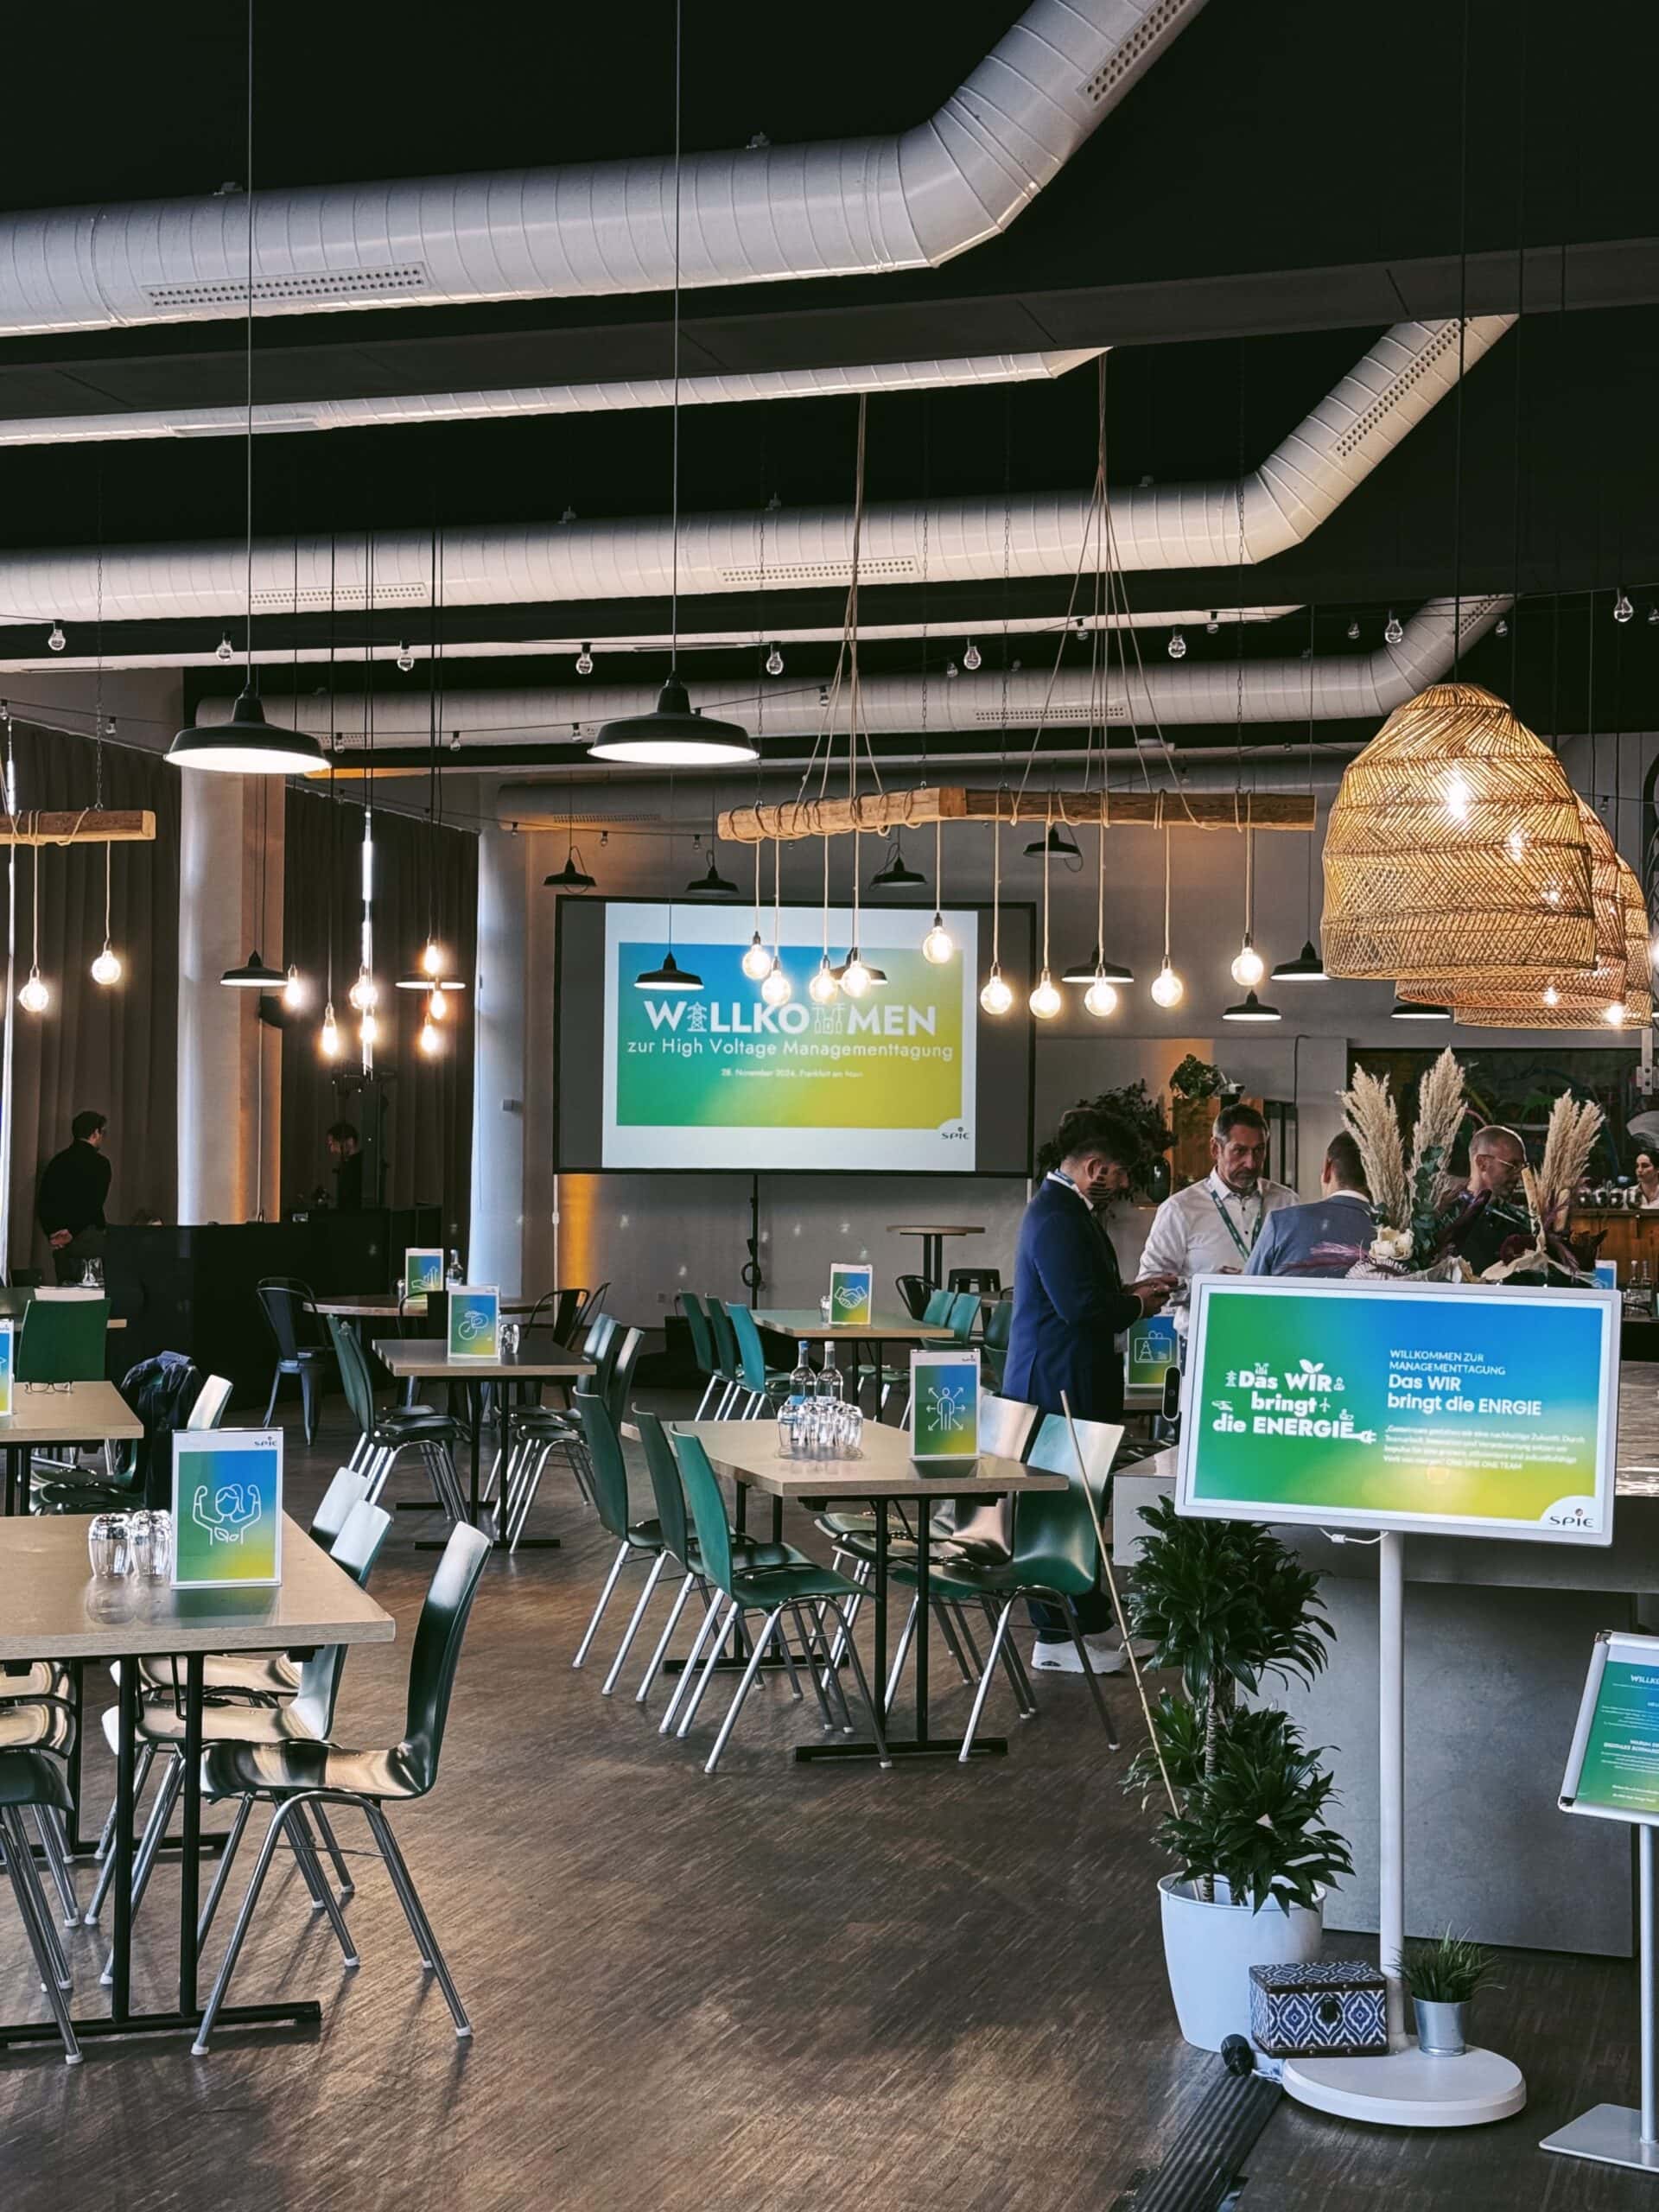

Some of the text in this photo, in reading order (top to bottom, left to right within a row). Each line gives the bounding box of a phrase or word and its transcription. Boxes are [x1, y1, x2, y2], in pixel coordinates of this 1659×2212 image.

[627, 1038, 954, 1062] zur High Voltage Managementtagung
[1389, 1350, 1484, 1363] WILLKOMMEN ZUR
[1389, 1362, 1506, 1376] MANAGEMENTTAGUNG
[1238, 1370, 1332, 1393] Das WIR
[1389, 1374, 1462, 1392] Das WIR
[1250, 1390, 1318, 1418] bringt
[1387, 1392, 1542, 1416] bringt die ENRGIE
[1211, 1412, 1355, 1440] die ENERGIE
